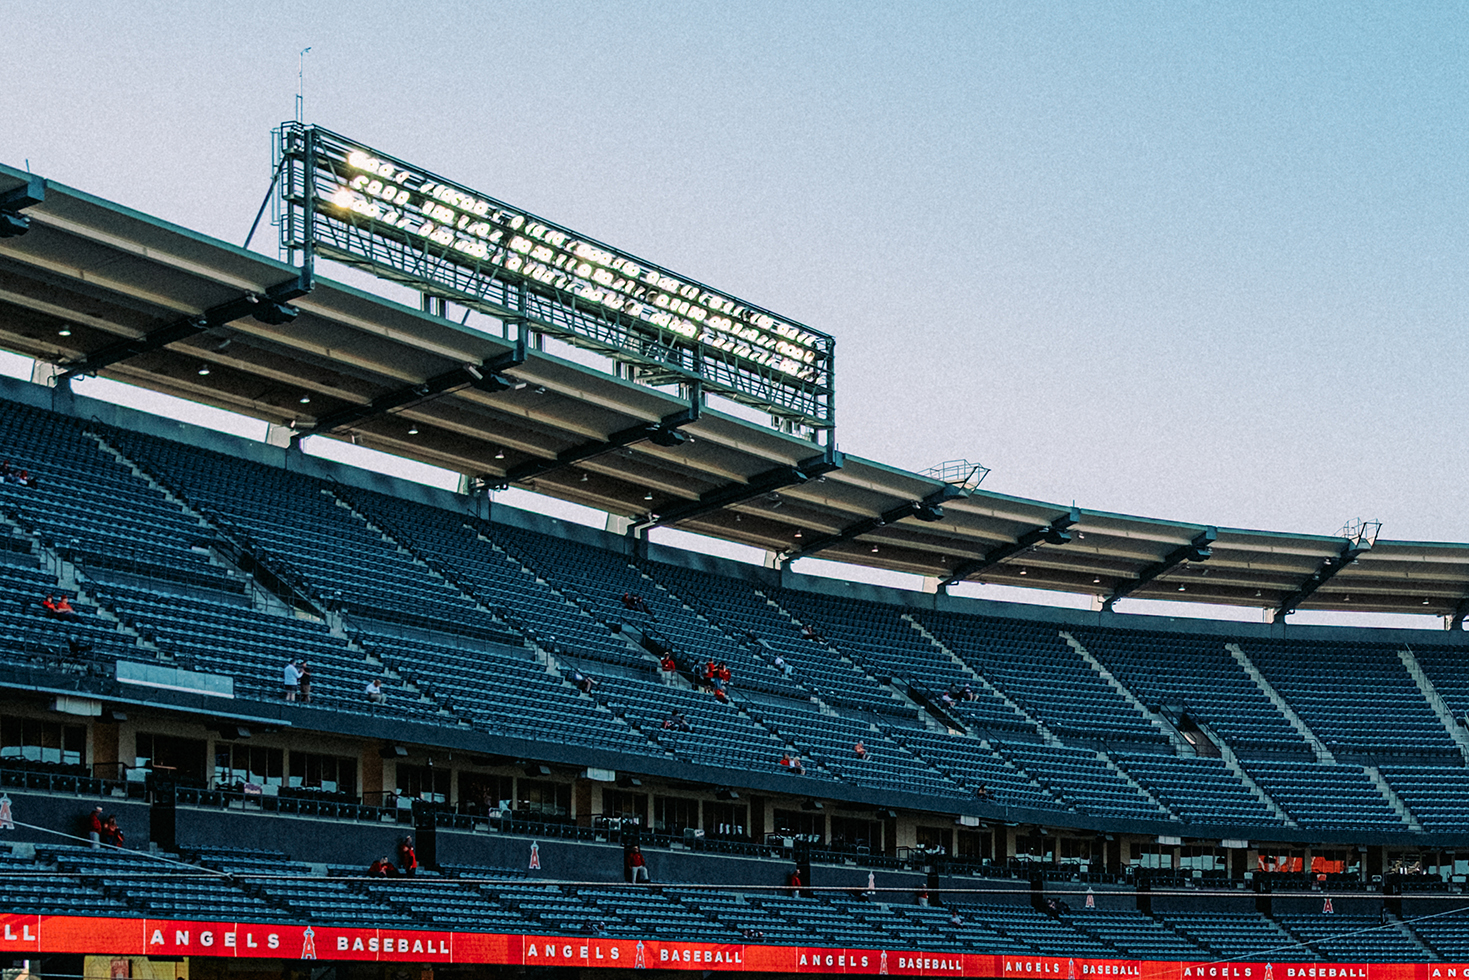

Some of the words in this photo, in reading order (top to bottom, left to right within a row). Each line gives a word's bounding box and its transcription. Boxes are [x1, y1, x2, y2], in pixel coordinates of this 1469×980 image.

[150, 929, 280, 949] ANGELS
[337, 936, 449, 955] BASEBALL
[527, 943, 620, 959] ANGELS
[660, 948, 743, 963] BASEBALL
[799, 953, 869, 967] ANGELS
[899, 957, 963, 971] BASEBALL
[1005, 961, 1060, 973] ANGELS
[1082, 964, 1140, 975] BASEBALL
[1184, 966, 1252, 977] ANGELS
[1287, 967, 1366, 978] BASEBALL
